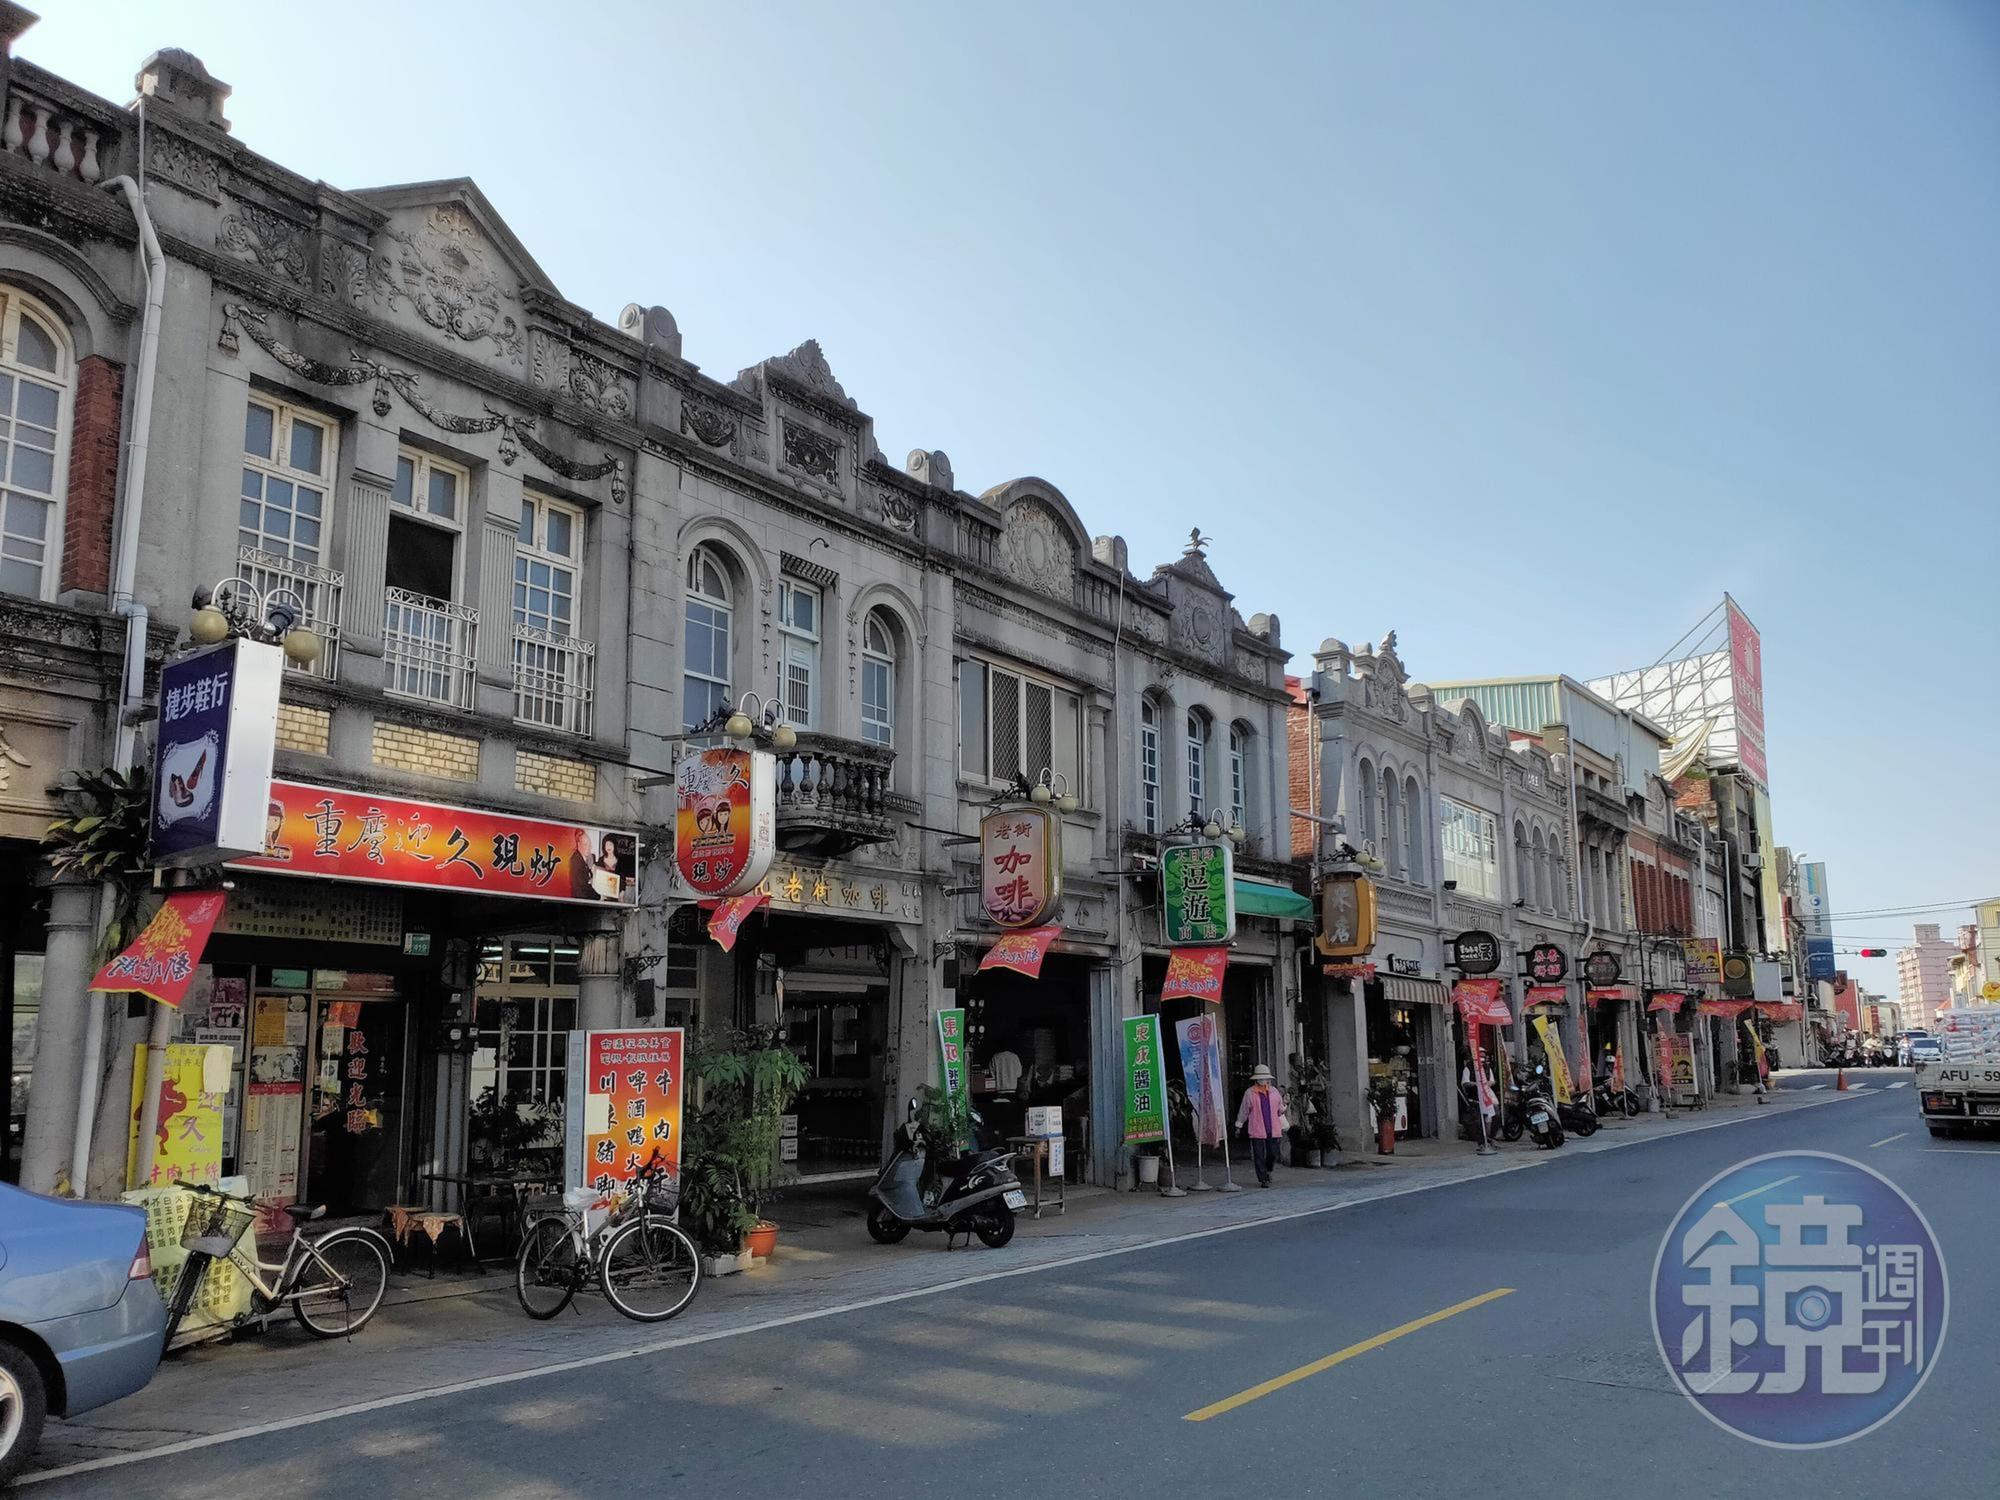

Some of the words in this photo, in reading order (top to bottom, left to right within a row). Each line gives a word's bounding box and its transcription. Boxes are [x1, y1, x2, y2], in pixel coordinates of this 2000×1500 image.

[165, 671, 228, 723] 捷步鞋行
[994, 822, 1033, 840] 老街
[691, 859, 733, 884] 現炒
[994, 845, 1033, 909] 咖啡
[754, 871, 889, 914] 老街咖啡
[1940, 1070, 1969, 1082] AFU
